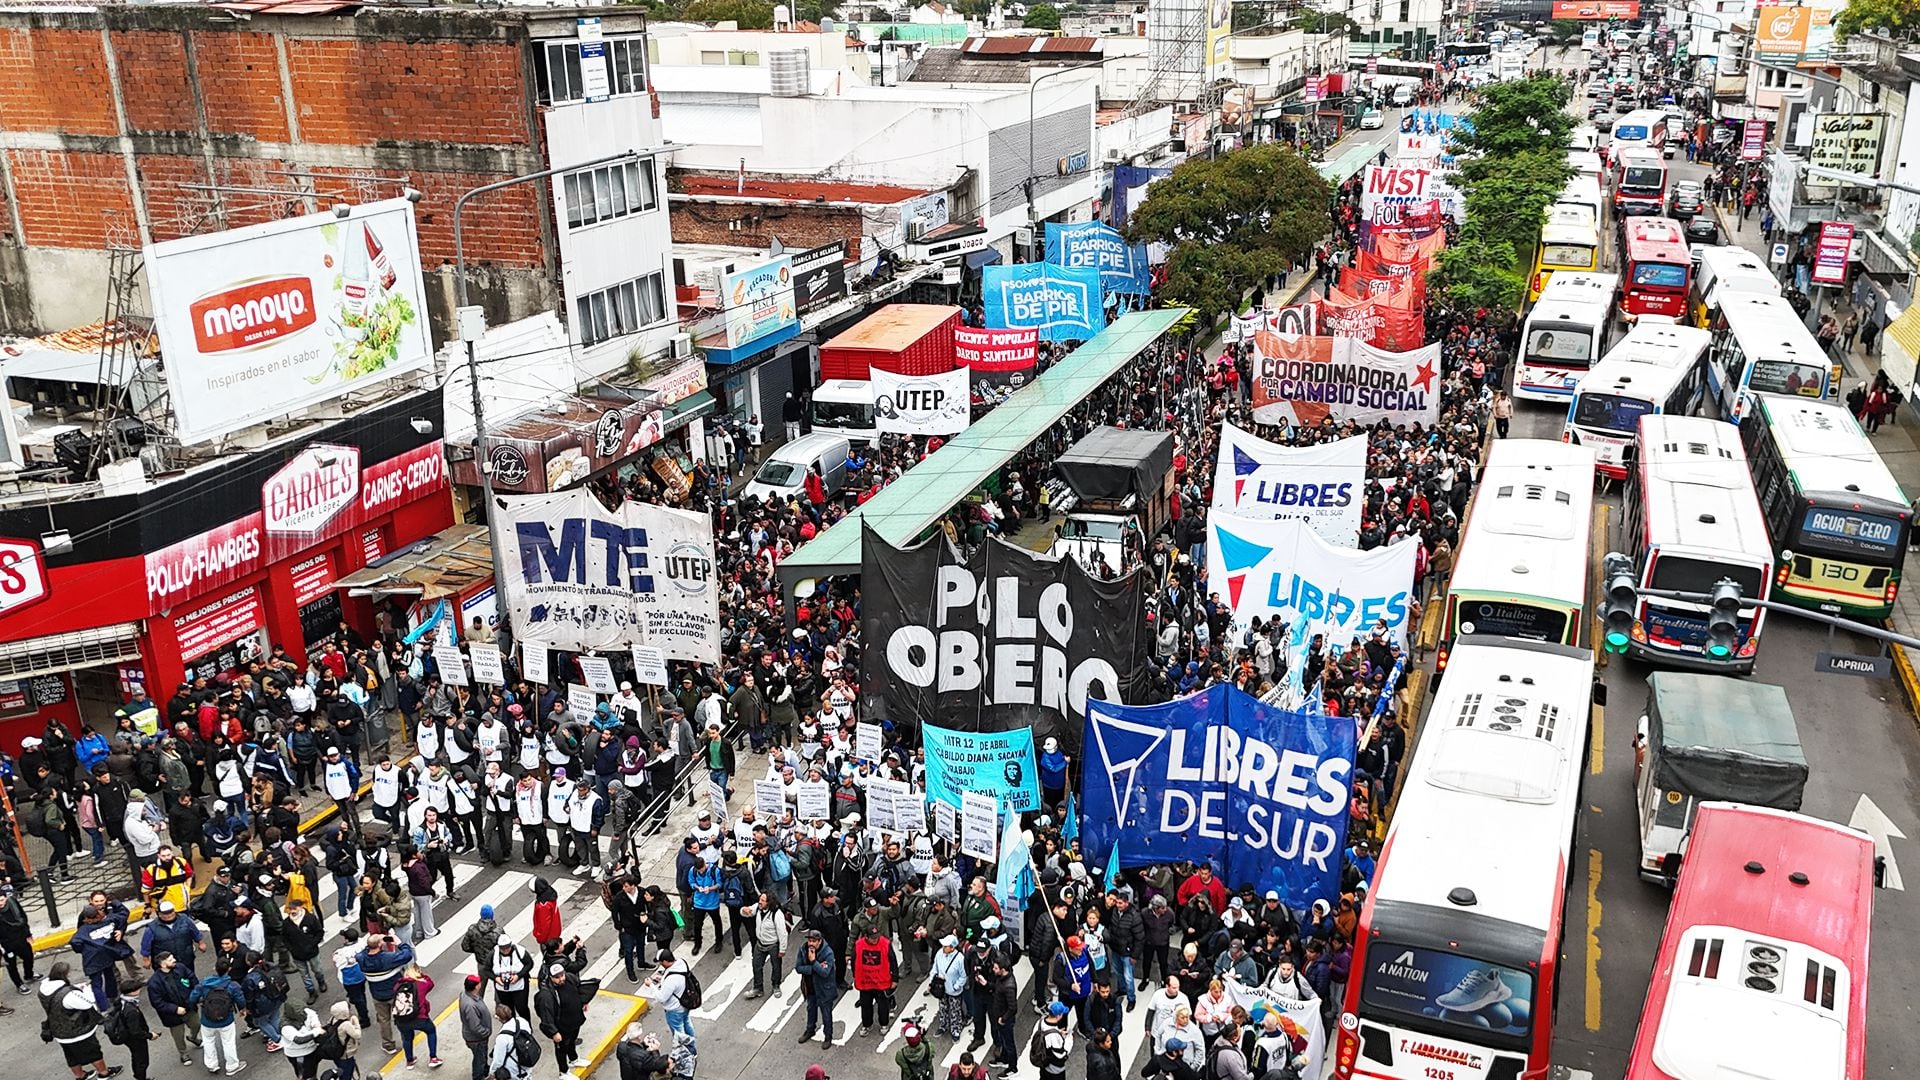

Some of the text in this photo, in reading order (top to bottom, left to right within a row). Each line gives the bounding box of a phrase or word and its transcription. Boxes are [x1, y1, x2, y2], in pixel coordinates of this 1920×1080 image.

[1815, 137, 1876, 149] DEPILION
[1369, 168, 1431, 196] MST
[1374, 205, 1401, 225] FOL
[962, 238, 984, 249] Joaco
[1070, 240, 1123, 253] BARRIOS
[1069, 252, 1125, 268] DE PIE
[1012, 289, 1077, 305] BARRIOS
[203, 289, 305, 338] menoyo
[1013, 301, 1079, 320] DE PIE
[954, 329, 1037, 345] FRENTE POPULAR
[956, 346, 1035, 362] DARIO SANTILLAN
[207, 348, 320, 391] Inspirados en el sabor
[1261, 358, 1408, 392] COORDINADORA
[662, 369, 700, 393] AUTOSERVICIO
[1261, 377, 1279, 389] POR
[895, 390, 945, 411] UTEP
[1268, 378, 1427, 411] EL CAMBIO SOCIAL
[271, 456, 353, 522] CARNES
[362, 453, 440, 511] CARNES-CERDO
[1256, 480, 1353, 508] LIBRES
[284, 512, 315, 527] Vicente
[1812, 513, 1892, 541] AGUA CERO
[146, 528, 260, 601] POLLO-FIAMBRES
[515, 518, 655, 594] MTE
[664, 556, 712, 582] UTEP
[1821, 563, 1859, 581] 130
[526, 585, 577, 596] MOVIMIENTO
[185, 601, 223, 622] MEJORES
[222, 585, 255, 606] PRECIOS
[936, 564, 1074, 649] POLO
[1267, 572, 1408, 632] LIBRES
[648, 611, 712, 626] POR UNA PATRIA
[1495, 608, 1537, 621] Italbus
[664, 621, 706, 632] ESCLAVOS
[1649, 615, 1713, 632] Tandilens
[886, 625, 1123, 721] OBERO
[1830, 659, 1875, 673] LAPRIDA
[574, 698, 591, 706] TECHO
[943, 735, 1010, 751] MTR 12 DE ABRIL
[935, 747, 1027, 763] CABILDO DIANA SACAYAN
[947, 763, 976, 776] TRABAJO
[1166, 725, 1352, 817] LIBRES
[970, 779, 975, 787] Y
[1023, 790, 1030, 799] 31
[1669, 793, 1680, 801] 110
[1003, 798, 1031, 811] RTIRO
[1243, 803, 1337, 873] SUR
[1378, 961, 1430, 984] A NATION
[1343, 1015, 1355, 1027] 60
[1424, 1067, 1454, 1080] 1205
